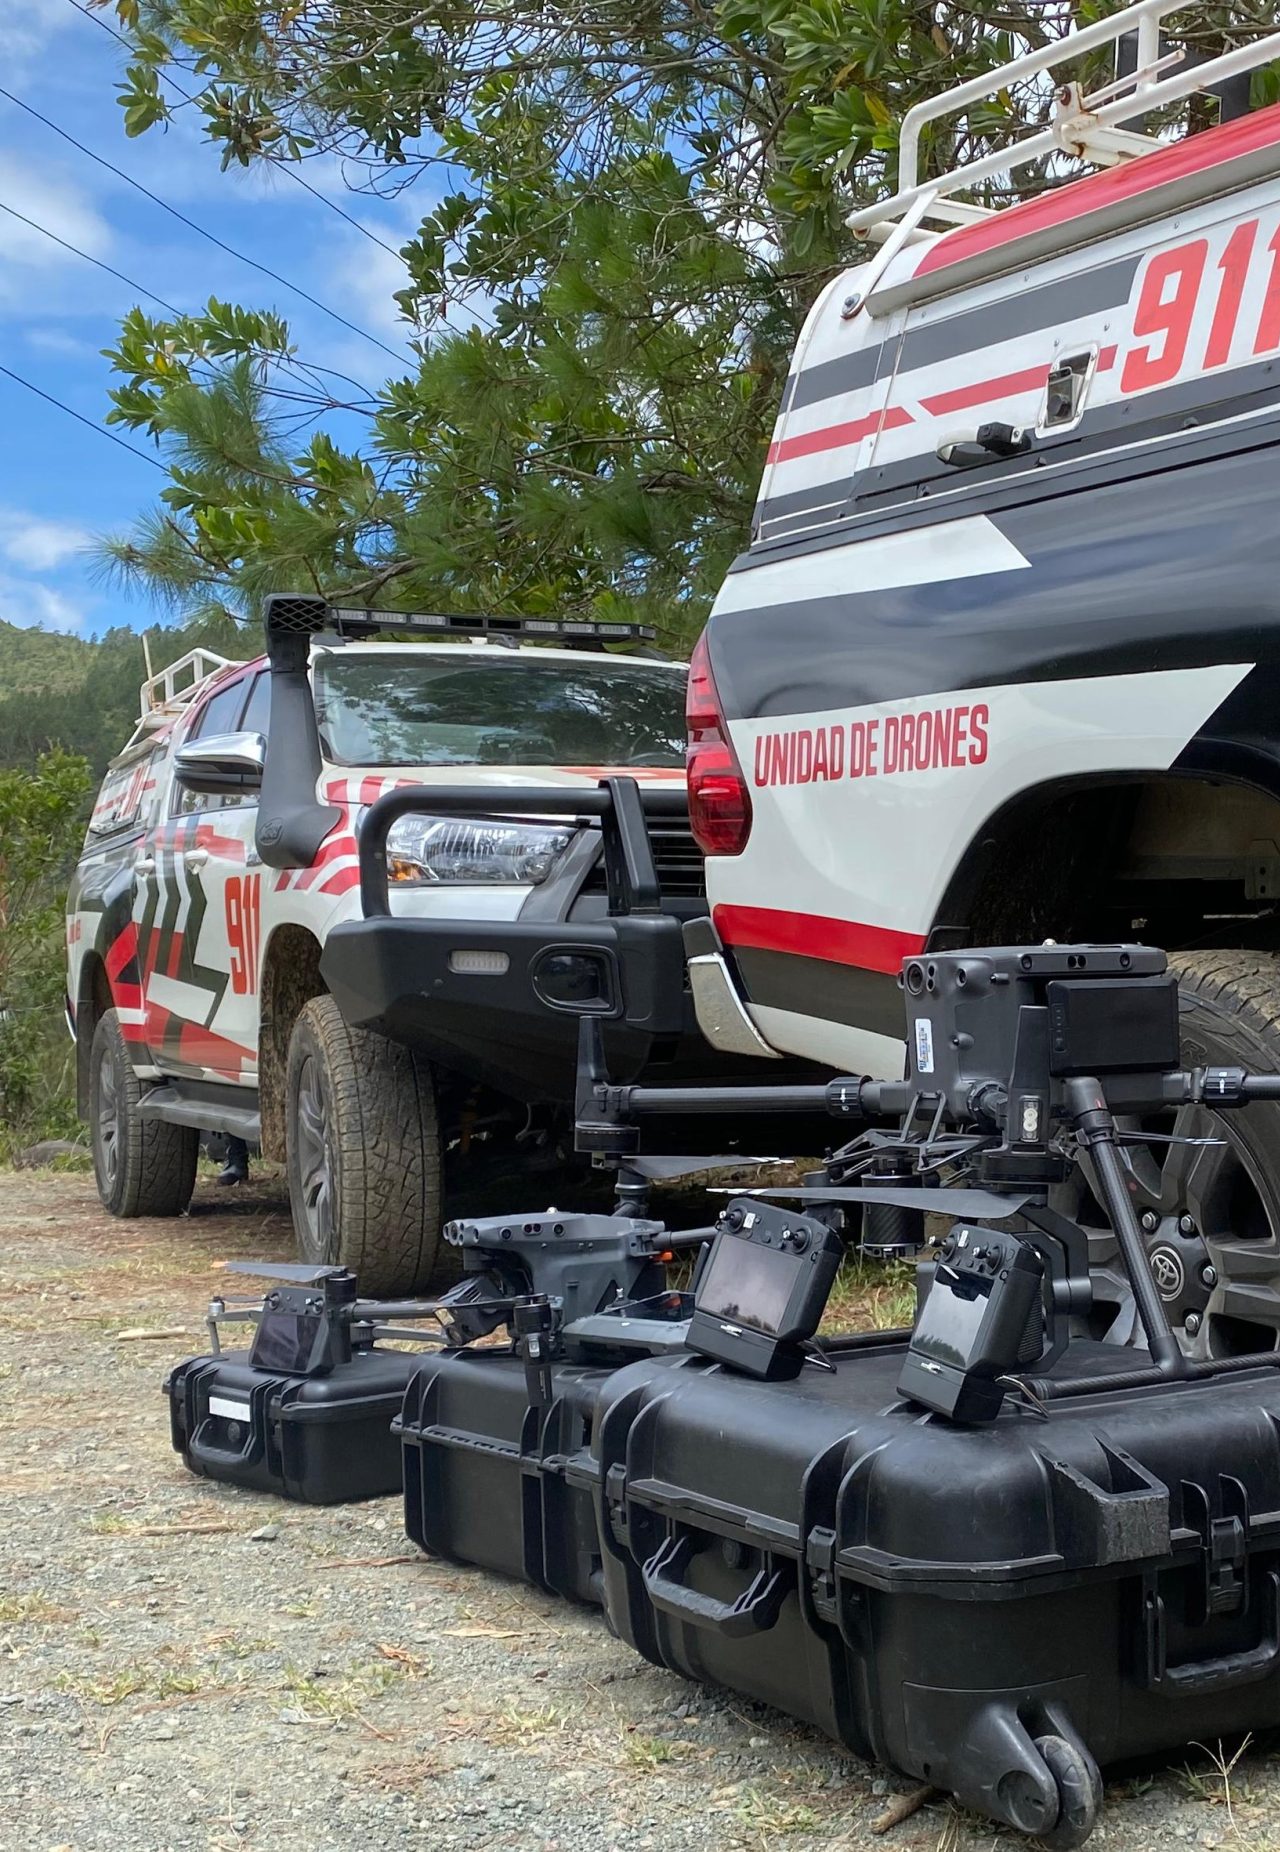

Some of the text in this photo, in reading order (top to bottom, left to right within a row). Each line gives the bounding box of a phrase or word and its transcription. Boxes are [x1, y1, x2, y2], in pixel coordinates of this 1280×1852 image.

[754, 703, 989, 787] UNIDAD DE DRONES
[225, 873, 261, 995] 911
